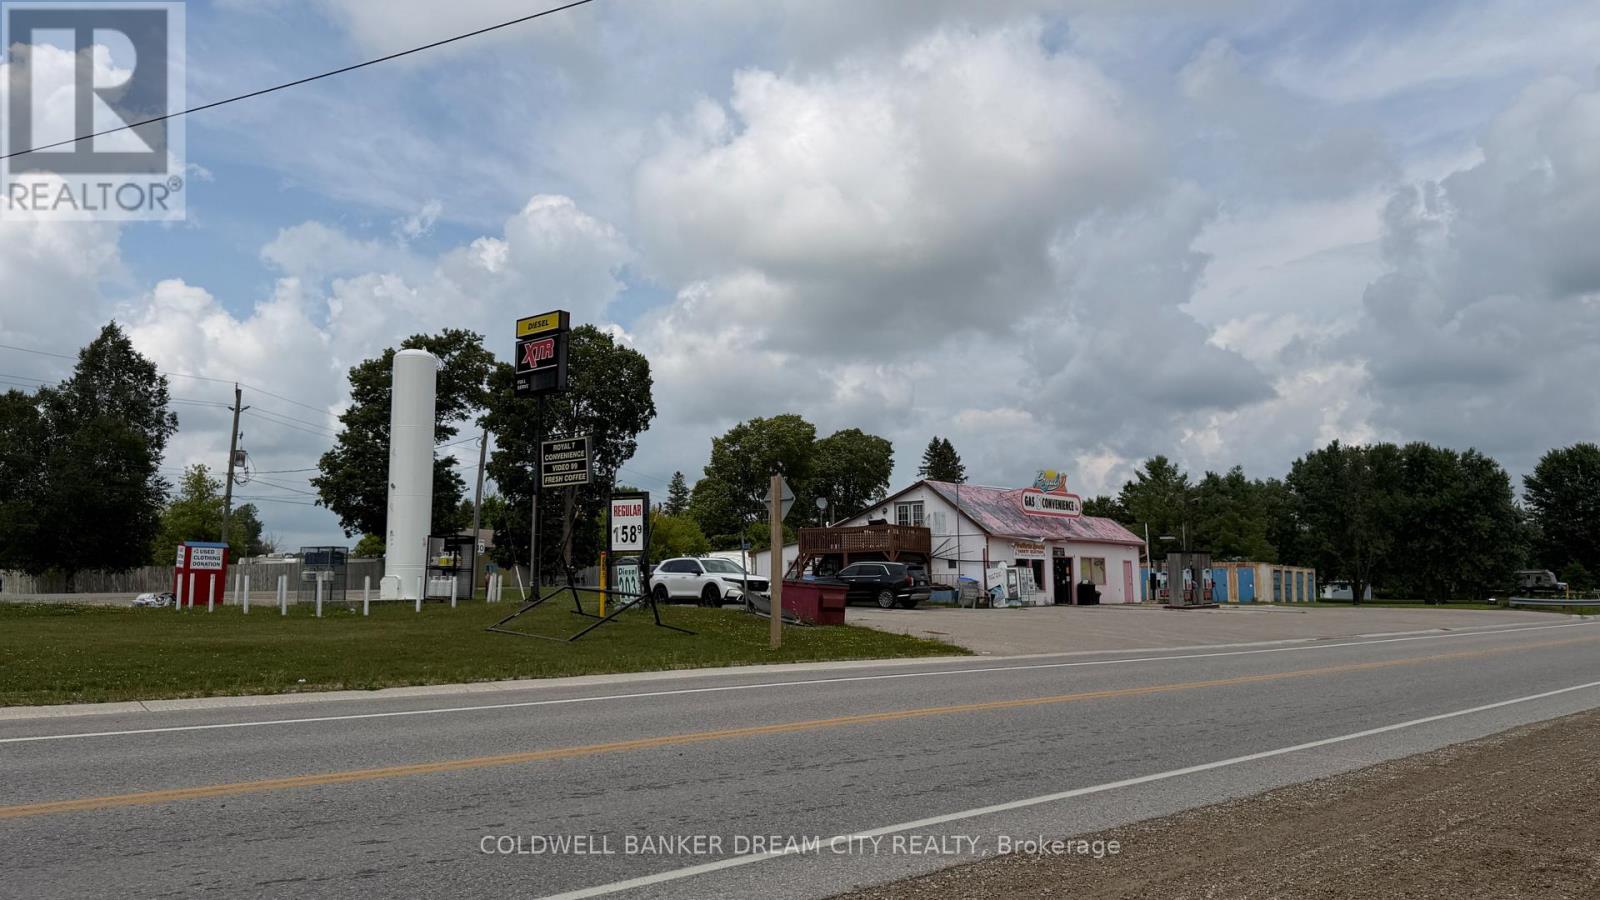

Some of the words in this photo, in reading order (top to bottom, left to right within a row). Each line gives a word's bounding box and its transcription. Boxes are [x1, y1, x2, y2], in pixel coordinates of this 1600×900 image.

[527, 319, 549, 330] DIESEL
[521, 338, 555, 368] XTR
[553, 442, 571, 451] ROYAL
[572, 441, 576, 449] T
[544, 450, 585, 461] CONVENIENCE
[552, 463, 570, 471] VIDEO
[544, 475, 563, 484] FRESH
[564, 472, 586, 482] COFFEE
[1024, 495, 1035, 507] GAS
[1042, 497, 1074, 511] CONVENIENCE
[613, 504, 642, 517] REGULAR
[618, 567, 637, 576] Diesel
